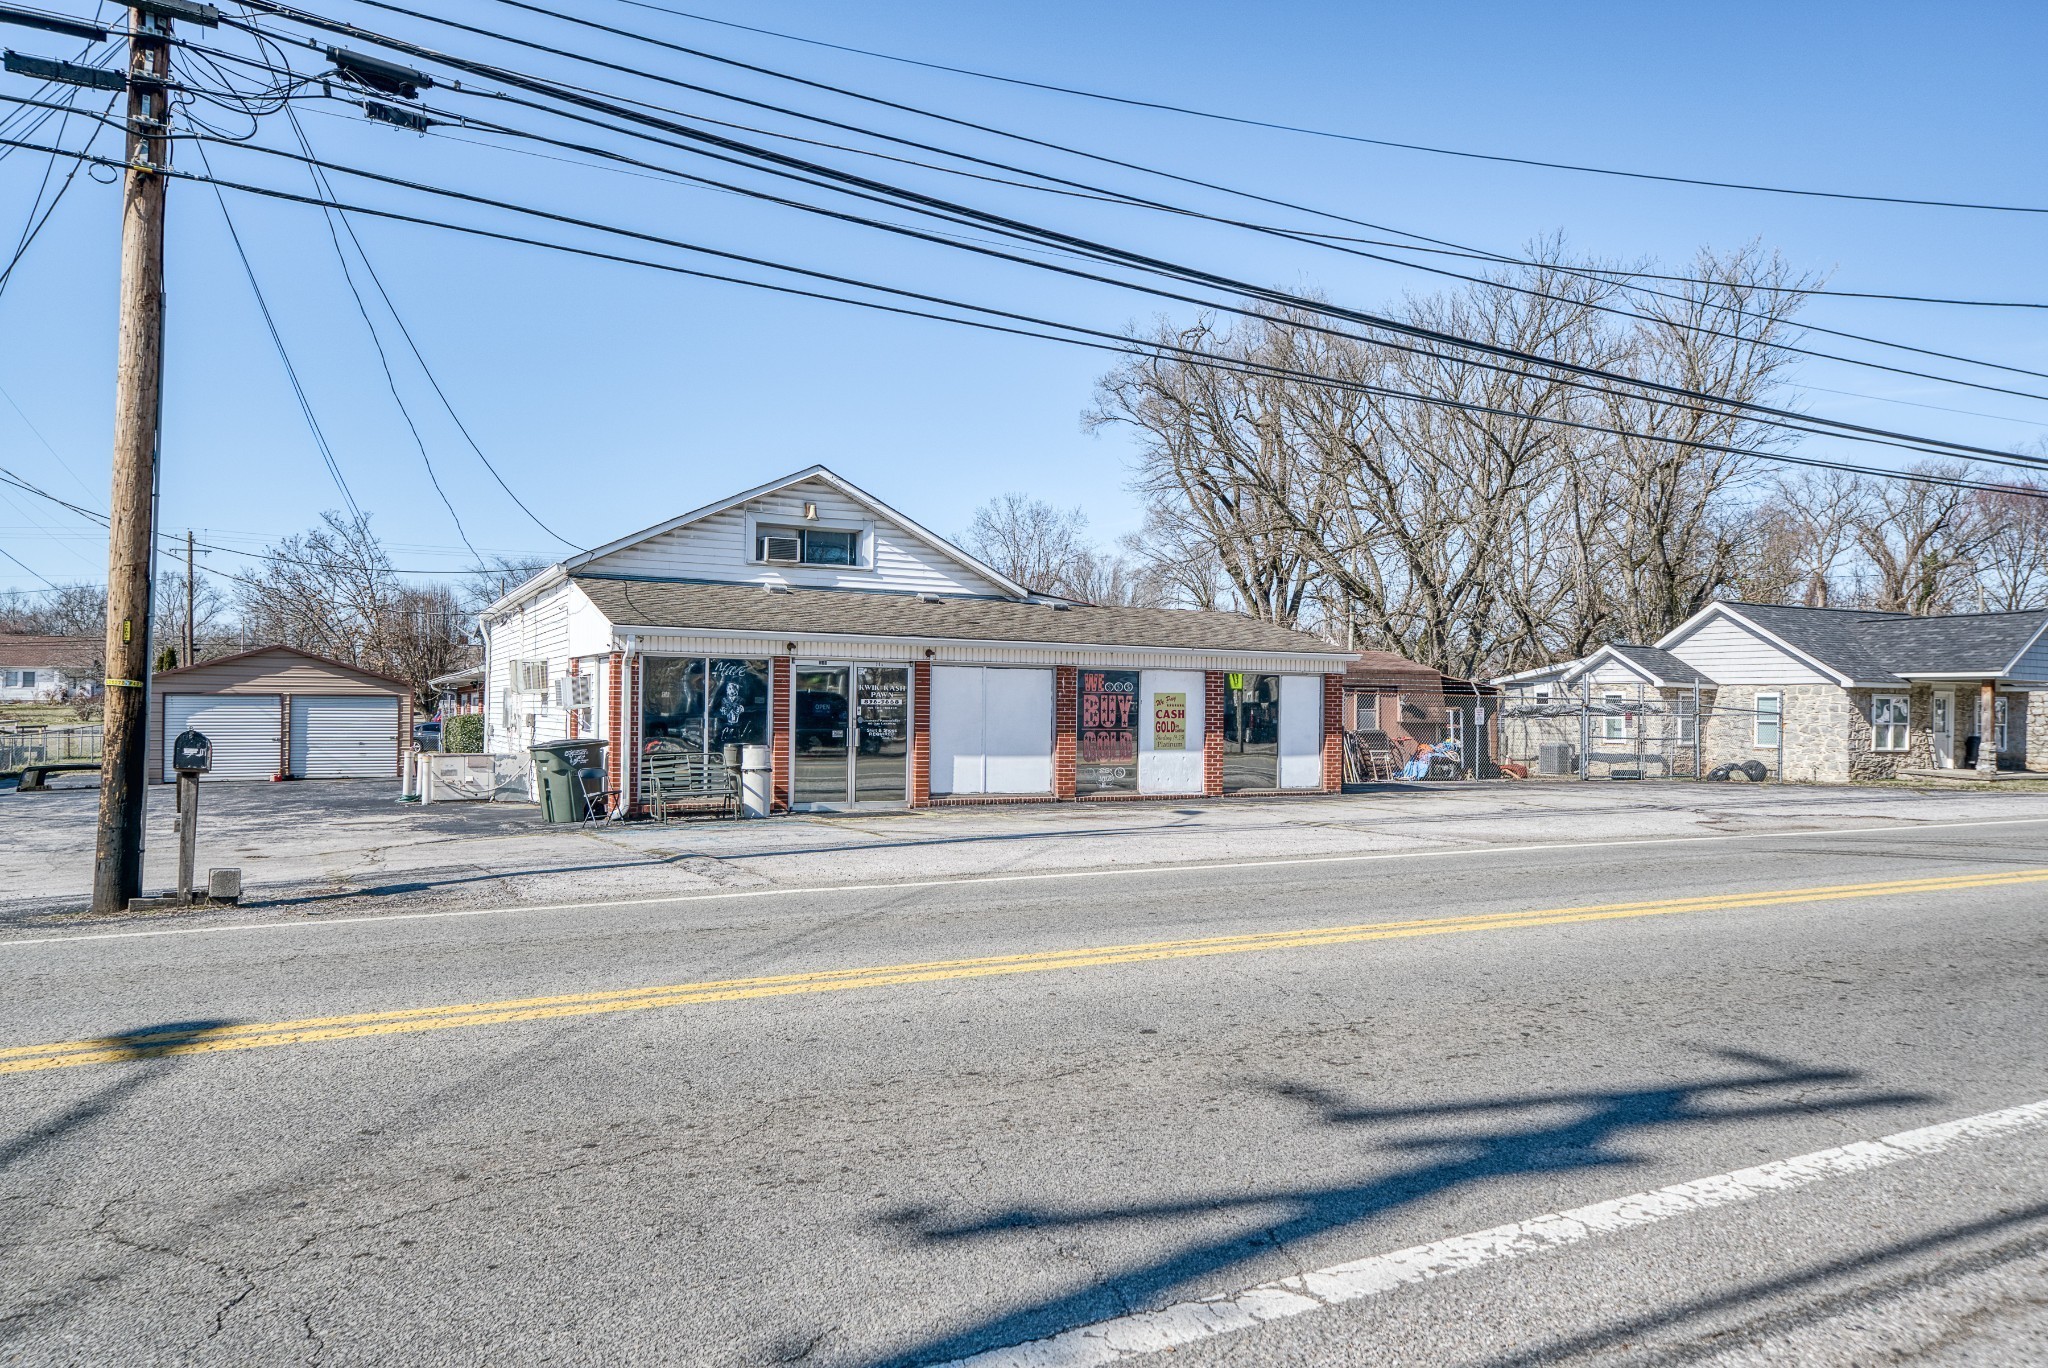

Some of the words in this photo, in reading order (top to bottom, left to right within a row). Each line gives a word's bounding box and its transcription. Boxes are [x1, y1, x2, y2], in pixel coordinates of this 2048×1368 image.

[1084, 674, 1105, 691] WE
[1083, 694, 1133, 728] BUY
[1155, 709, 1185, 719] CASH
[1155, 720, 1176, 733] GOLD
[1083, 731, 1133, 762] GOLD
